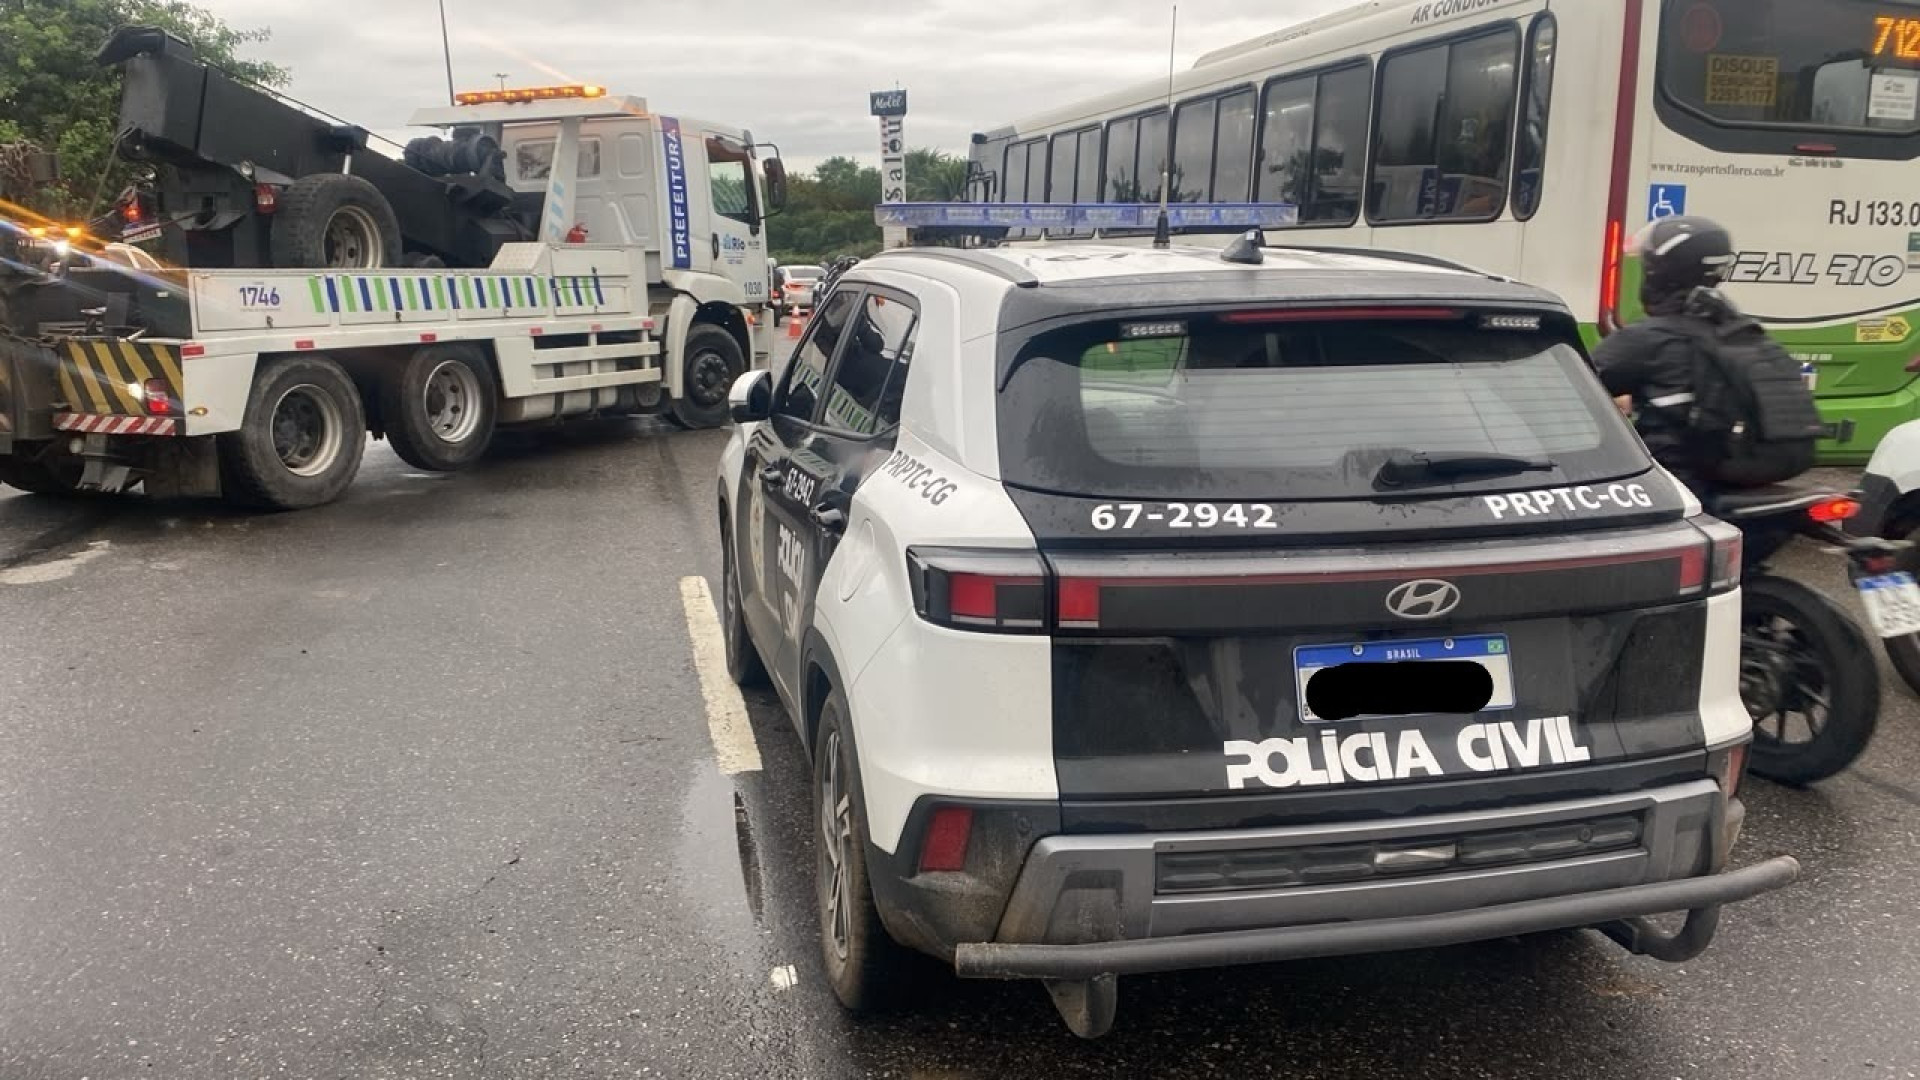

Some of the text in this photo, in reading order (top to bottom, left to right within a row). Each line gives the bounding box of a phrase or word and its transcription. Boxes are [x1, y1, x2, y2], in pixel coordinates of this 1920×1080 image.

[1411, 5, 1430, 24] AR
[1874, 17, 1920, 57] 712
[1711, 57, 1776, 76] DISQUE
[666, 128, 688, 259] PREFEITURA
[1829, 199, 1861, 225] RJ
[1827, 254, 1905, 287] RIO
[239, 286, 280, 306] 1746
[743, 281, 763, 295] 1030
[881, 449, 957, 506] PRPTC-CG
[1484, 483, 1653, 519] PRPTC-CG
[1091, 502, 1278, 530] 67-2942
[1387, 648, 1421, 660] BRASIL
[1223, 716, 1591, 790] POLÍCIA CIVIL
